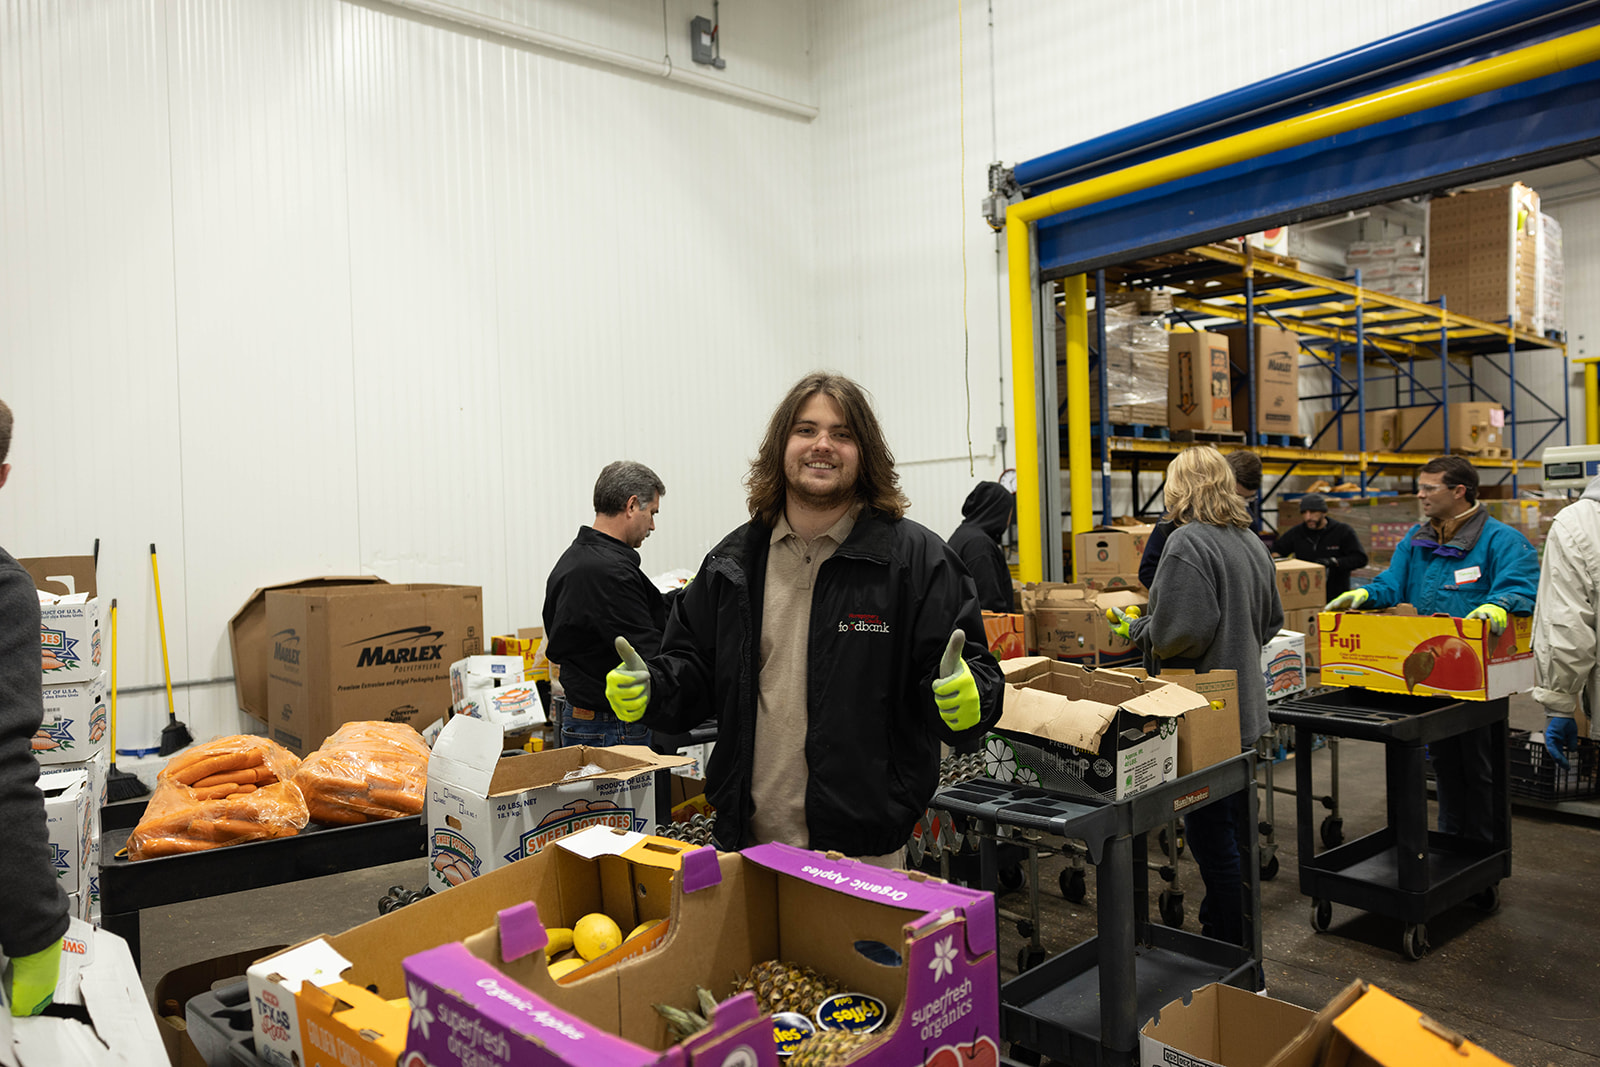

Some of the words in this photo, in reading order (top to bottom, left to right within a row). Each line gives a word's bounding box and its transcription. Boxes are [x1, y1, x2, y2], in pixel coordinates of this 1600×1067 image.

[838, 620, 890, 633] foodbank
[1329, 633, 1361, 653] Fuji
[356, 643, 445, 668] MARLEX
[595, 780, 626, 791] PRODUCT
[626, 778, 635, 786] OF
[497, 803, 507, 811] 40
[523, 797, 538, 807] NET
[435, 834, 450, 847] SWEET
[527, 824, 570, 853] SWEET
[573, 814, 631, 833] POTATOES
[800, 865, 850, 885] Apples
[849, 879, 909, 901] Organic
[475, 978, 534, 1012] Organic
[527, 1010, 586, 1040] Apples
[832, 1000, 880, 1023] Fyffes
[911, 976, 972, 1027] superfresh
[255, 997, 291, 1030] TEXAS
[920, 998, 973, 1041] organics
[437, 1003, 511, 1062] superfresh
